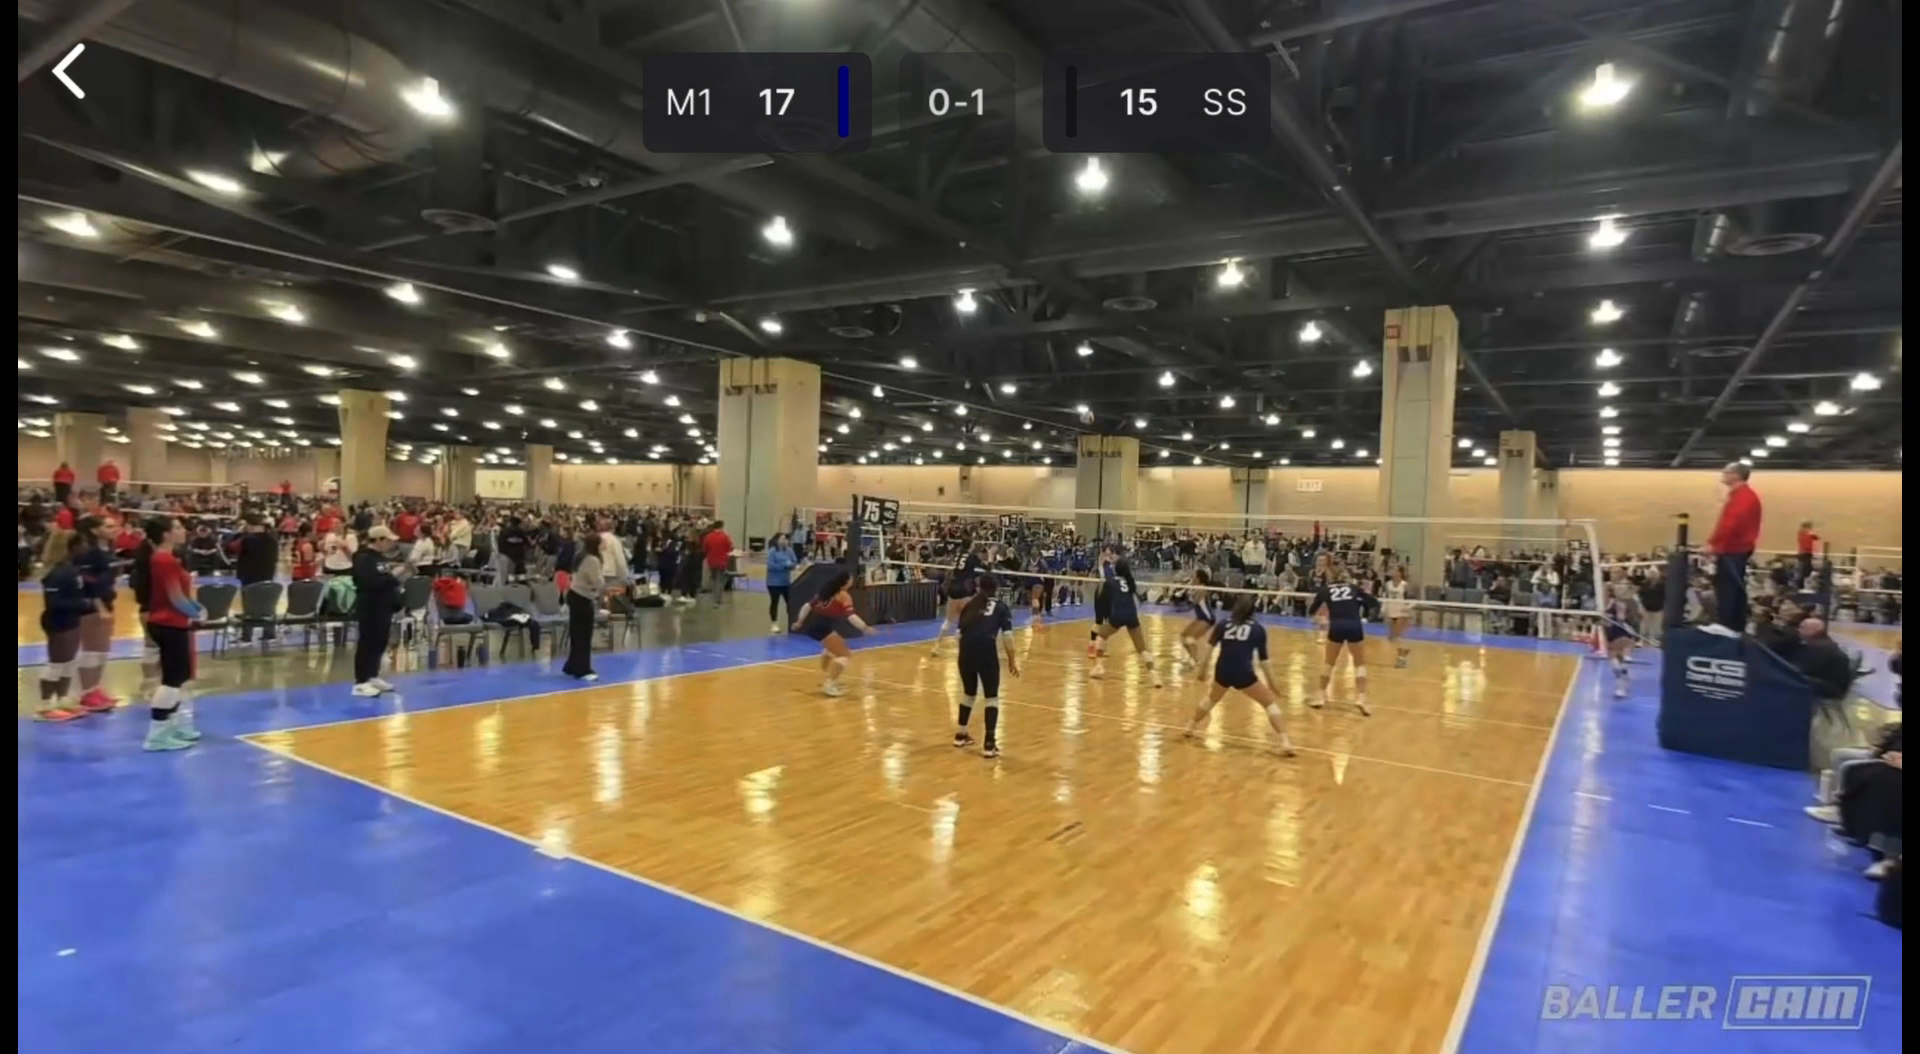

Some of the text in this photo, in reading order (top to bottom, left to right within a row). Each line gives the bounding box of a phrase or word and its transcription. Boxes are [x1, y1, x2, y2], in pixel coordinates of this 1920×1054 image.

[864, 500, 880, 522] 75
[1120, 580, 1129, 592] 5
[1330, 586, 1353, 601] 22
[1223, 622, 1252, 641] 20
